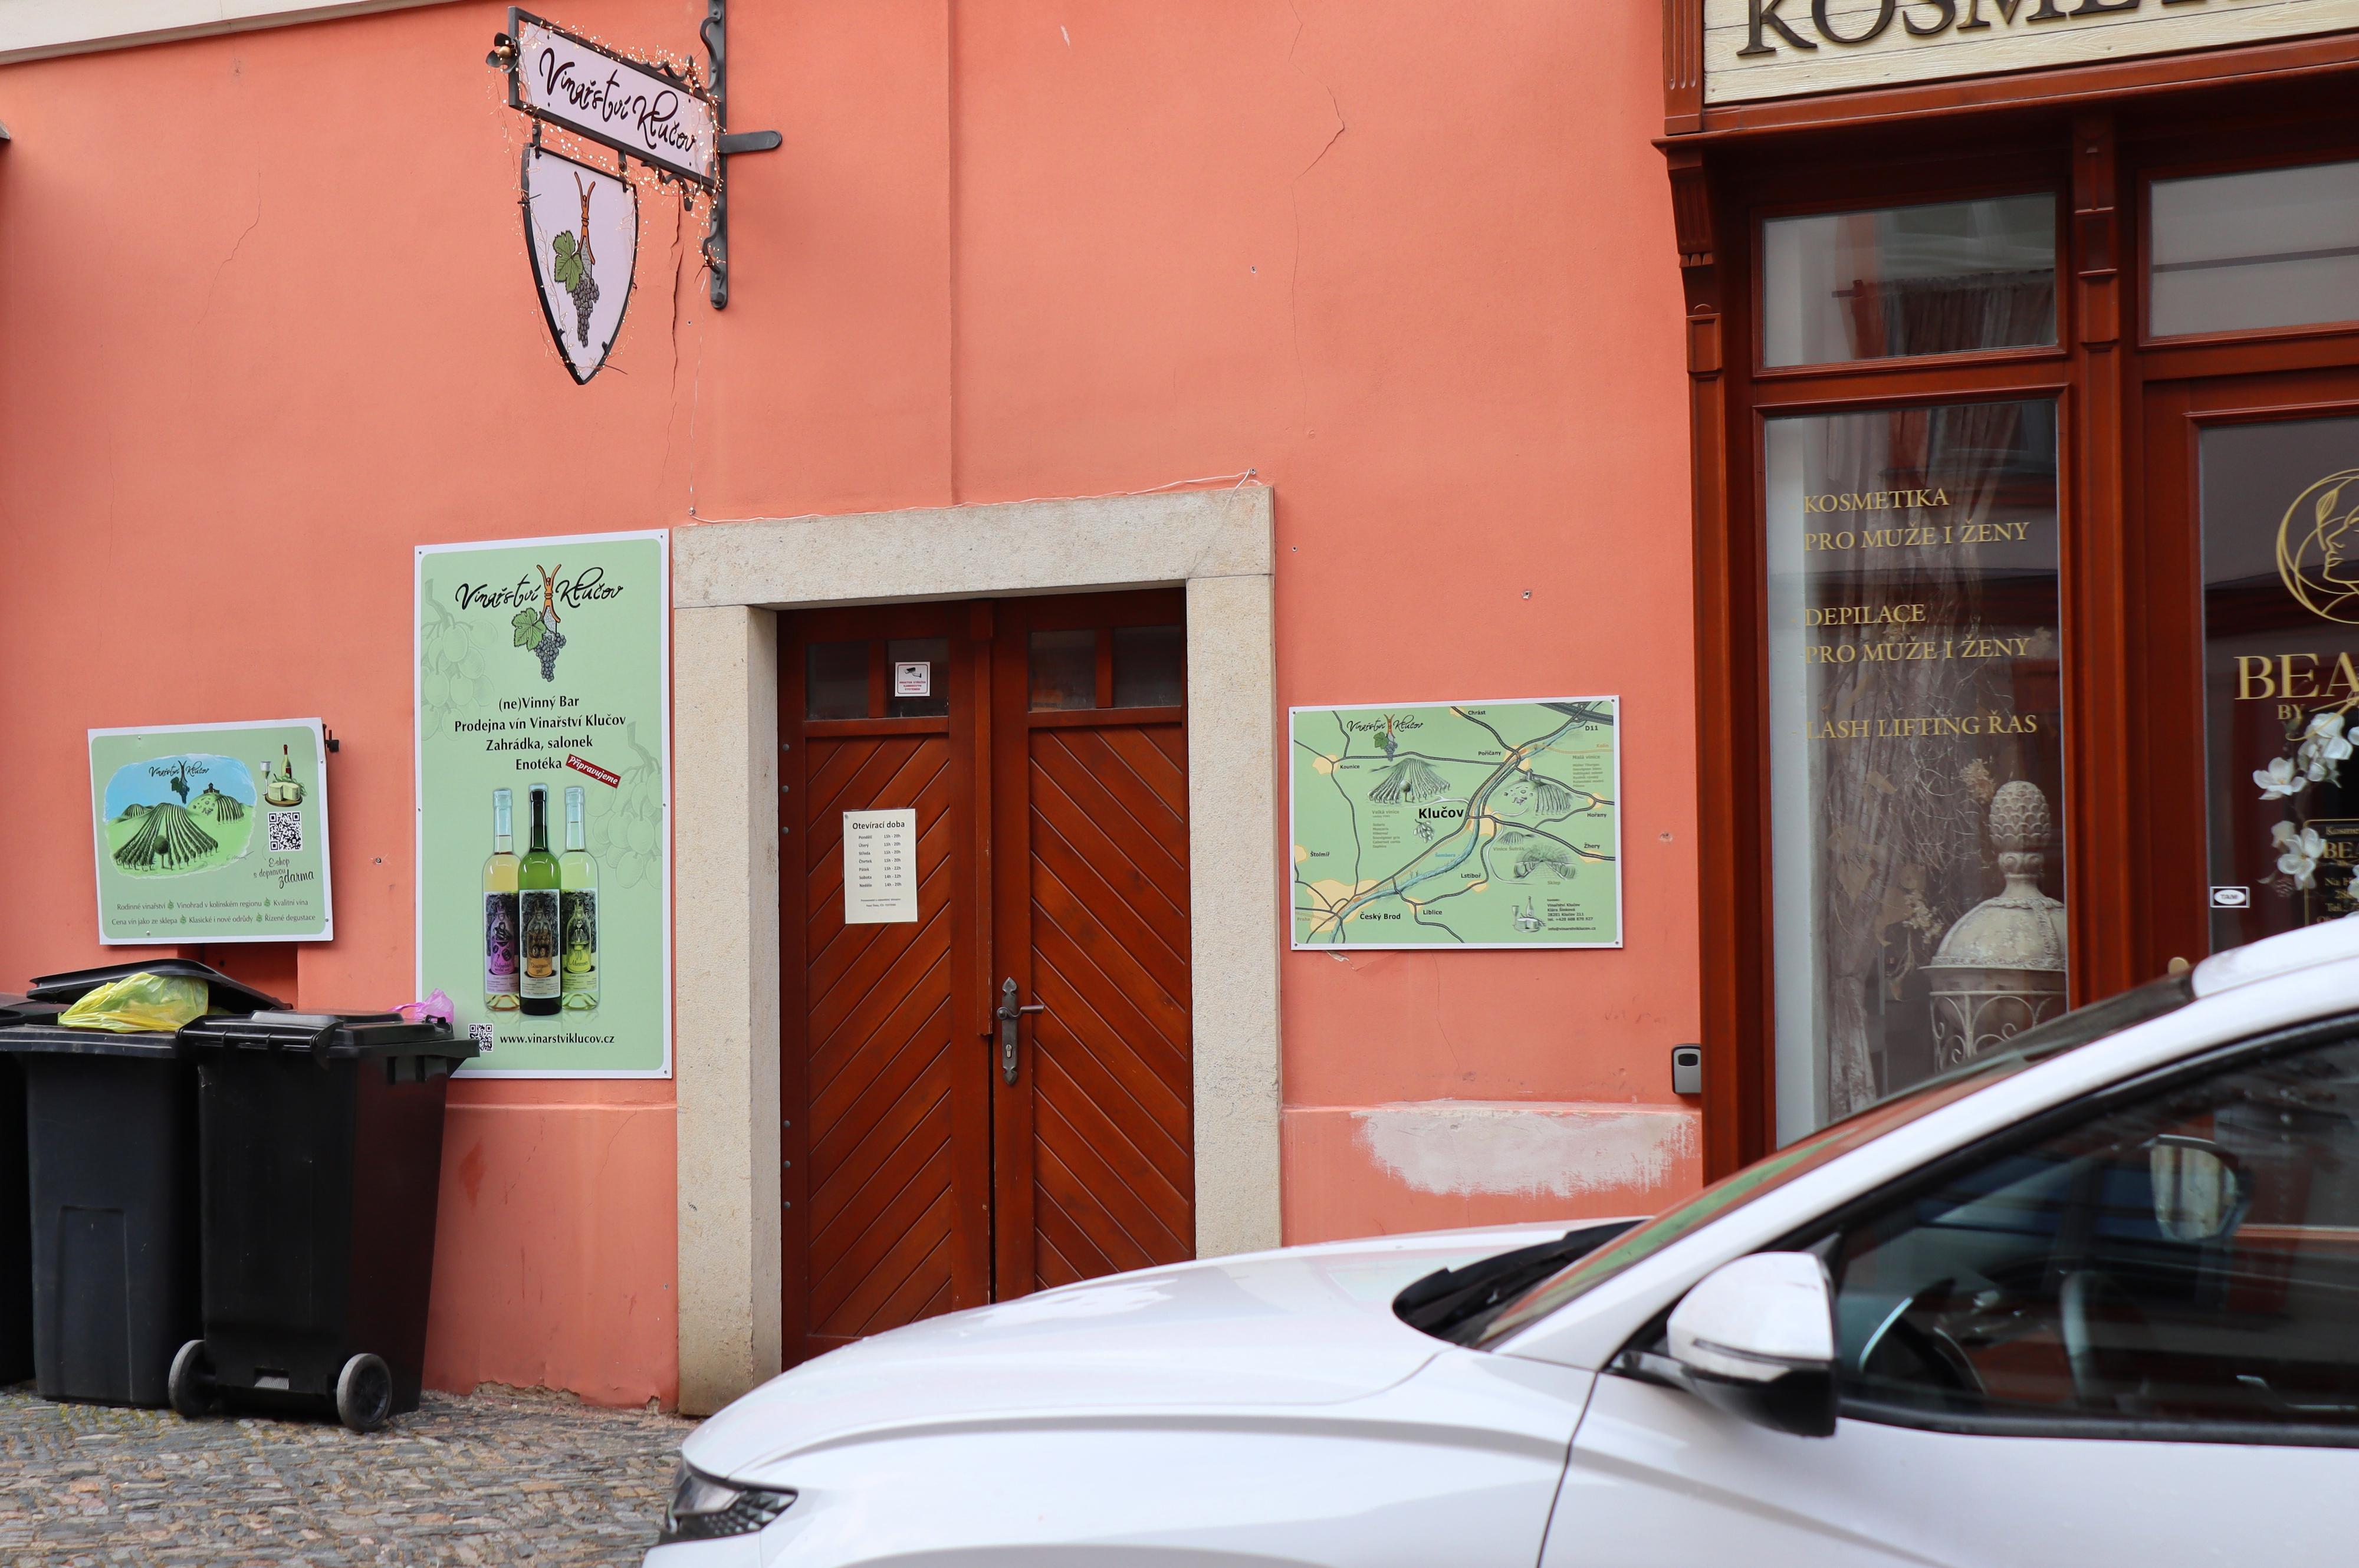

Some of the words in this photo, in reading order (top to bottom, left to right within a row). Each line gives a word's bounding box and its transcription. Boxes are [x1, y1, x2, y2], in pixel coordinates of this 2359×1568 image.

[539, 47, 631, 122] Vinařství
[632, 90, 697, 152] Klučov
[1804, 487, 1950, 513] KOSMETIKA
[1805, 531, 1855, 550] PRO
[1861, 521, 1937, 548] MUŽE
[1943, 527, 1952, 544] I
[1961, 518, 2029, 543] ŽENY
[455, 574, 541, 610] Vinařství
[556, 567, 623, 608] Klučov
[1805, 604, 1926, 626] DEPILACE
[1805, 644, 1856, 663] PRO
[1862, 636, 1937, 661] MUŽE
[1944, 641, 1952, 658] I
[1962, 634, 2031, 658] ŽENY
[499, 696, 556, 712] (ne)Vinný
[559, 696, 579, 707] Bar
[455, 720, 505, 734] Prodejna
[509, 718, 526, 729] vín
[530, 716, 582, 728] Vinařství
[585, 714, 626, 727] Klučov
[1807, 719, 1873, 739] LASH
[1878, 716, 1981, 737] LIFTING
[1987, 709, 2038, 734] ŘAS
[486, 738, 544, 752] Zahrádka,
[547, 735, 593, 748] salonek
[516, 757, 562, 771] Enotéka
[568, 756, 618, 784] Připravujeme
[1419, 806, 1464, 818] Klučov
[852, 821, 885, 830] Otevírací
[268, 857, 290, 867] E-shop
[259, 868, 286, 879] dopravou
[278, 869, 315, 889] zdarma
[209, 900, 238, 908] kolínském
[239, 900, 262, 909] regionu
[137, 918, 150, 926] jako
[159, 917, 178, 925] sklepa
[232, 915, 253, 923] odrůdy
[285, 914, 316, 922] degustace
[1360, 911, 1381, 922] Český
[500, 1033, 615, 1044] www.vinarstviklucov.cz
